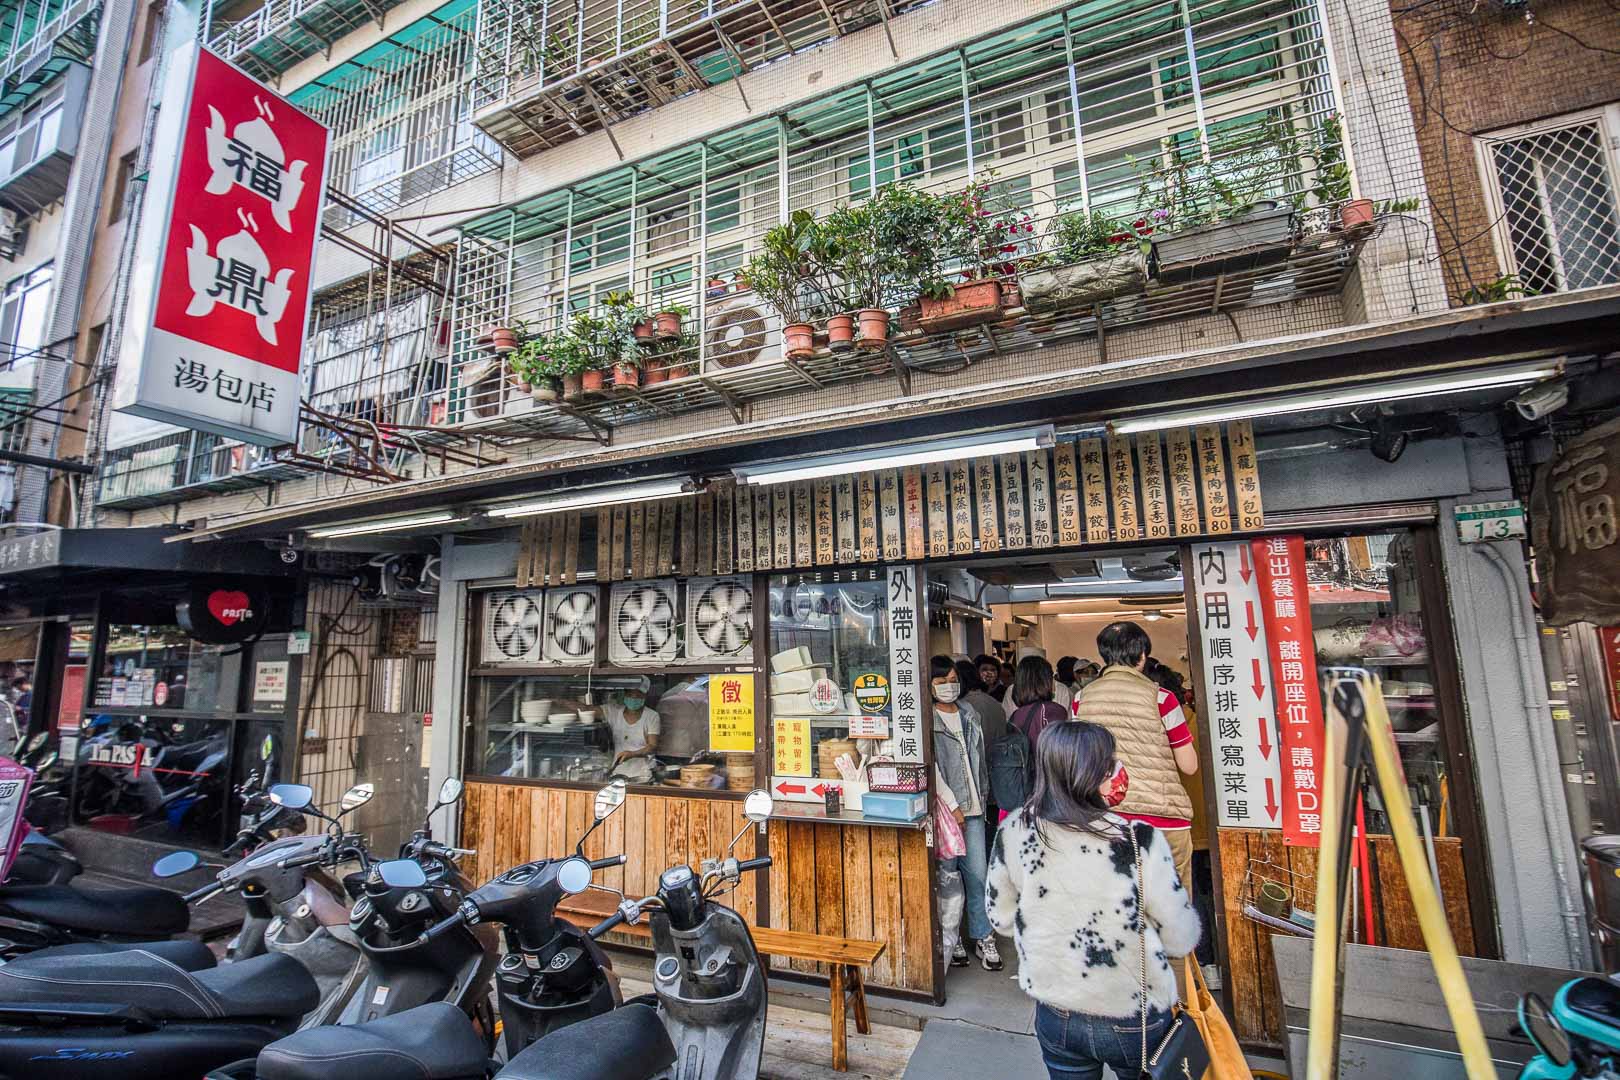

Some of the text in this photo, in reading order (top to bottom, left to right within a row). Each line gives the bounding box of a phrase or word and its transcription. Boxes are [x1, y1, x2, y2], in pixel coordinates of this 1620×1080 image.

[174, 356, 277, 412] 湯包店
[1234, 433, 1262, 528] 小籠湯包 80
[1085, 451, 1108, 541] 蝦仁蒸餃 110
[1005, 463, 1024, 547] 油豆腐細粉 80
[1031, 460, 1049, 545] 大骨湯麵 70
[861, 480, 875, 548] 豆沙鍋餅
[1151, 525, 1167, 537] 90
[1181, 523, 1197, 534] 80
[1211, 519, 1229, 532] 80
[1474, 519, 1510, 539] 13
[1061, 531, 1078, 542] 130
[1120, 528, 1135, 539] 90
[933, 544, 946, 554] 60
[955, 541, 971, 552] 100
[982, 539, 996, 551] 70
[819, 554, 831, 563] 70
[841, 551, 853, 560] 40
[886, 547, 898, 558] 40
[777, 556, 787, 566] 45
[222, 607, 254, 622] PASTA
[890, 568, 918, 757] 外帶交單後等候
[721, 680, 742, 704] 徵
